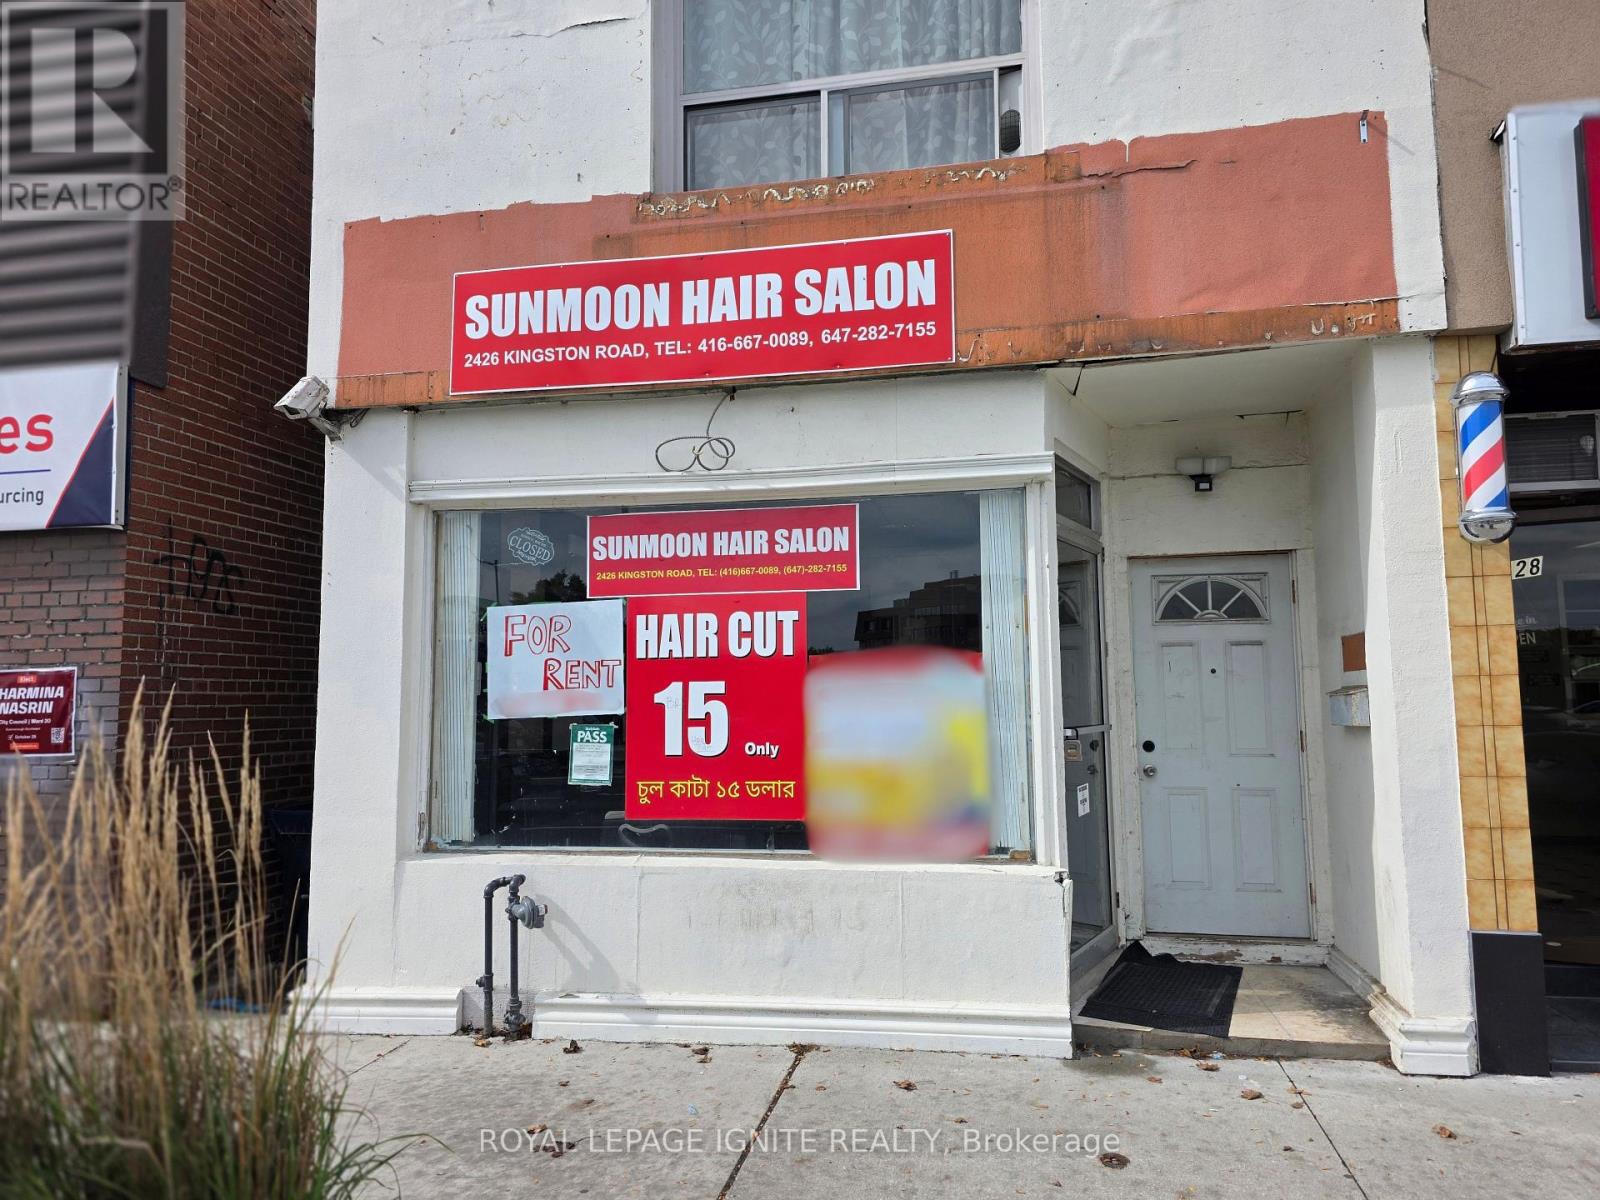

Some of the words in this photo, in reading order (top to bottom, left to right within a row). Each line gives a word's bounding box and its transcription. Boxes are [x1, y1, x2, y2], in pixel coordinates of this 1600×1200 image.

[465, 282, 670, 340] SUNMOON
[682, 272, 783, 325] HAIR
[794, 259, 936, 316] SALON
[464, 351, 500, 367] 2426
[504, 345, 590, 365] KINGSTON
[595, 343, 649, 359] ROAD,
[654, 340, 692, 355] TEL:
[698, 331, 814, 353] 416-667-0089,
[821, 321, 936, 344] 647-282-7155
[509, 535, 551, 561] CLOSED
[592, 532, 708, 561] SUNMOON
[713, 530, 769, 556] HAIR
[774, 526, 849, 554] SALON
[596, 571, 616, 580] 2426
[618, 570, 664, 579] KINGSTON
[666, 569, 695, 578] ROAD,
[697, 568, 717, 577] TEL:
[719, 566, 781, 576] (416)667-0089,
[783, 564, 848, 576] (647)-282-7155
[1514, 557, 1541, 578] 28
[504, 614, 572, 657] FOR
[636, 612, 719, 659] HAIR
[728, 610, 799, 658] CUT
[1516, 631, 1537, 646] EN
[542, 657, 622, 691] RENT
[0, 701, 53, 715] NASRIN
[653, 680, 729, 757] 15
[577, 730, 608, 743] PASS
[744, 742, 780, 758] Only
[636, 779, 665, 805] চুল
[669, 774, 711, 799] কাটা
[716, 780, 740, 799] ১৫
[745, 779, 796, 799] ডলার
